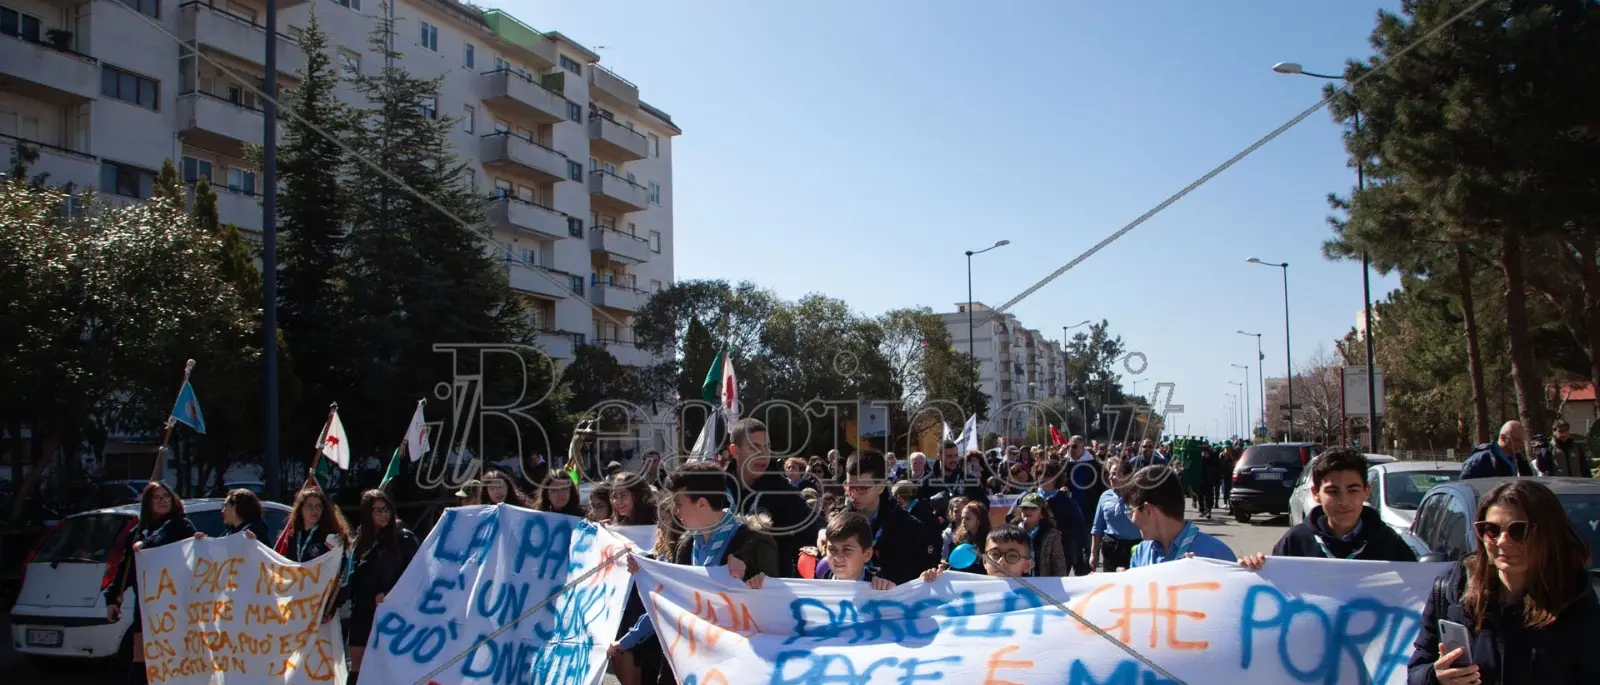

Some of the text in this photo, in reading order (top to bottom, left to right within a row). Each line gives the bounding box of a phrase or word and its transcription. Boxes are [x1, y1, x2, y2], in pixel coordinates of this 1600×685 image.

[433, 508, 500, 567] LA
[143, 556, 322, 603] LA PACE NON
[477, 579, 530, 630] UN
[1072, 581, 1221, 649] CHE
